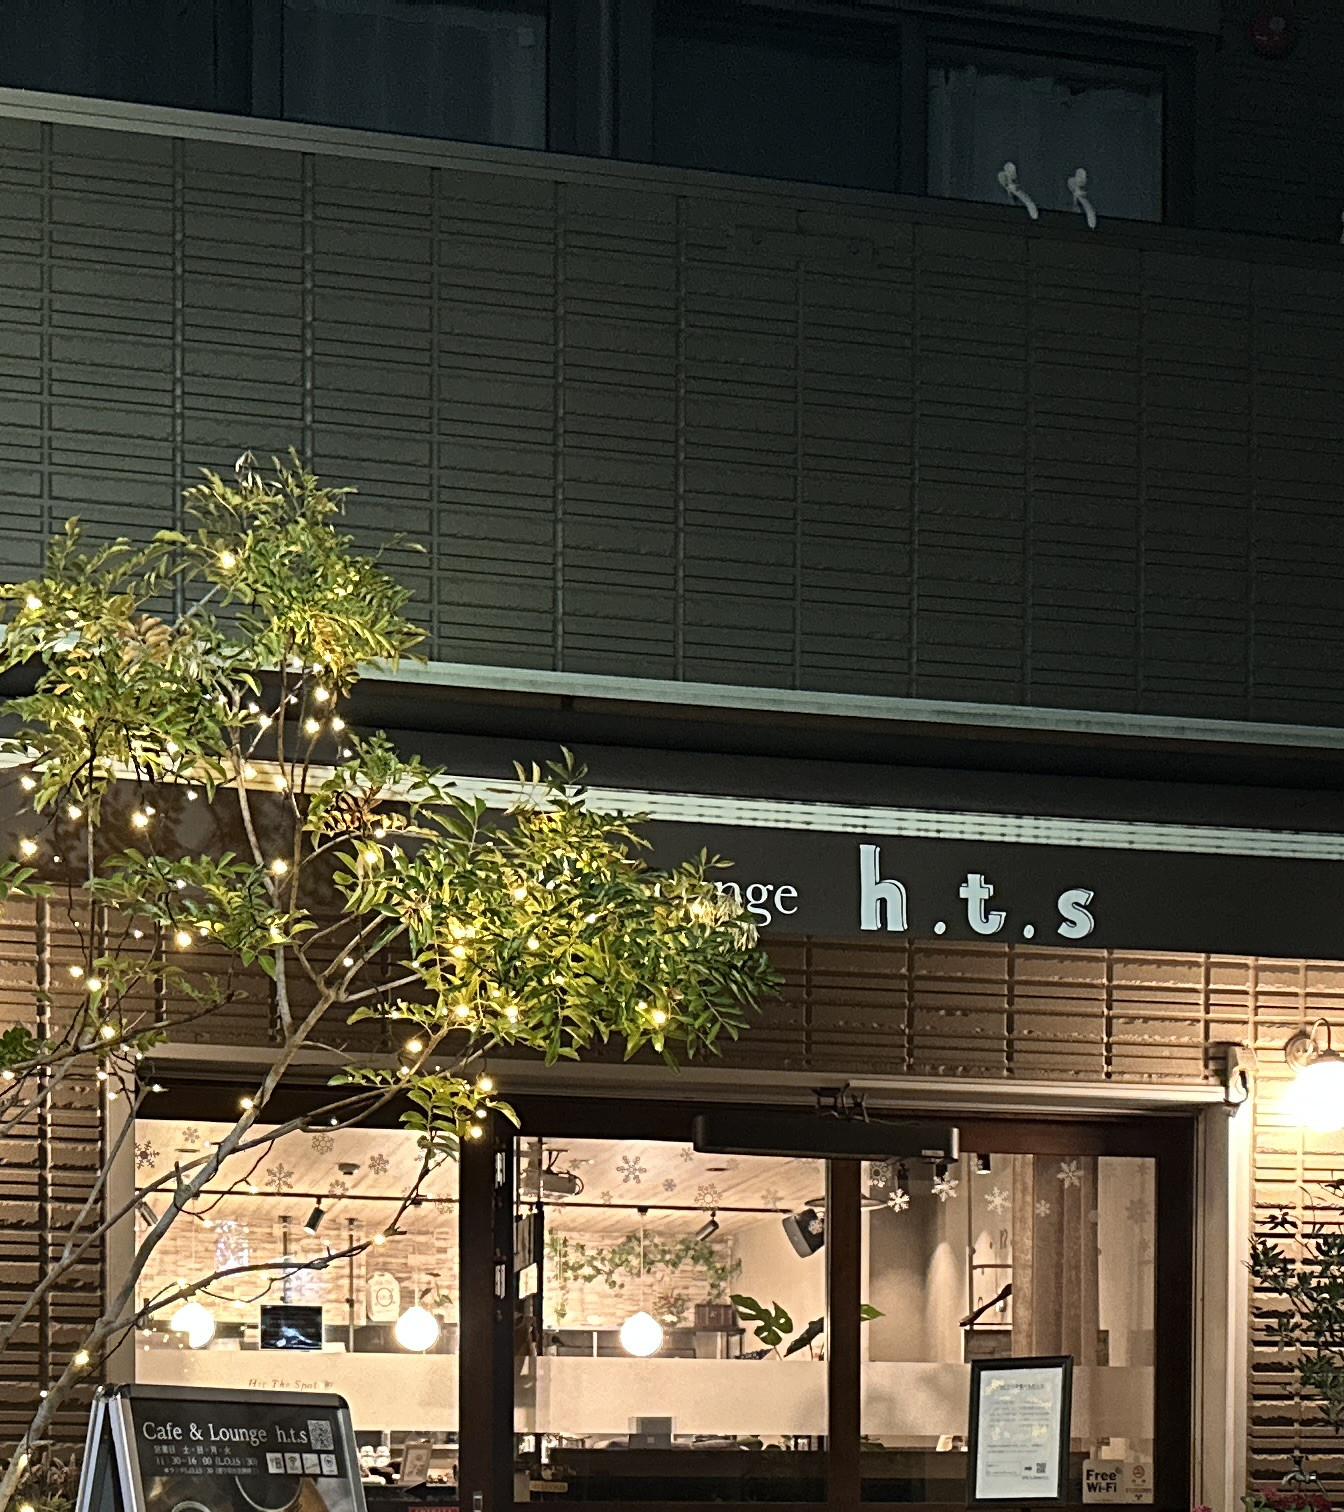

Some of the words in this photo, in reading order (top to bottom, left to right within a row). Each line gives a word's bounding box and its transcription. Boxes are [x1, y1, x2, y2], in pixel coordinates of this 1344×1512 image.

[859, 843, 1095, 939] h.t.s
[142, 1421, 183, 1441] Cafe
[189, 1422, 204, 1441] &
[208, 1423, 268, 1447] Lounge
[276, 1425, 308, 1444] h.t.s
[1086, 1469, 1117, 1481] Free
[1086, 1482, 1117, 1493] Wi-Fi
